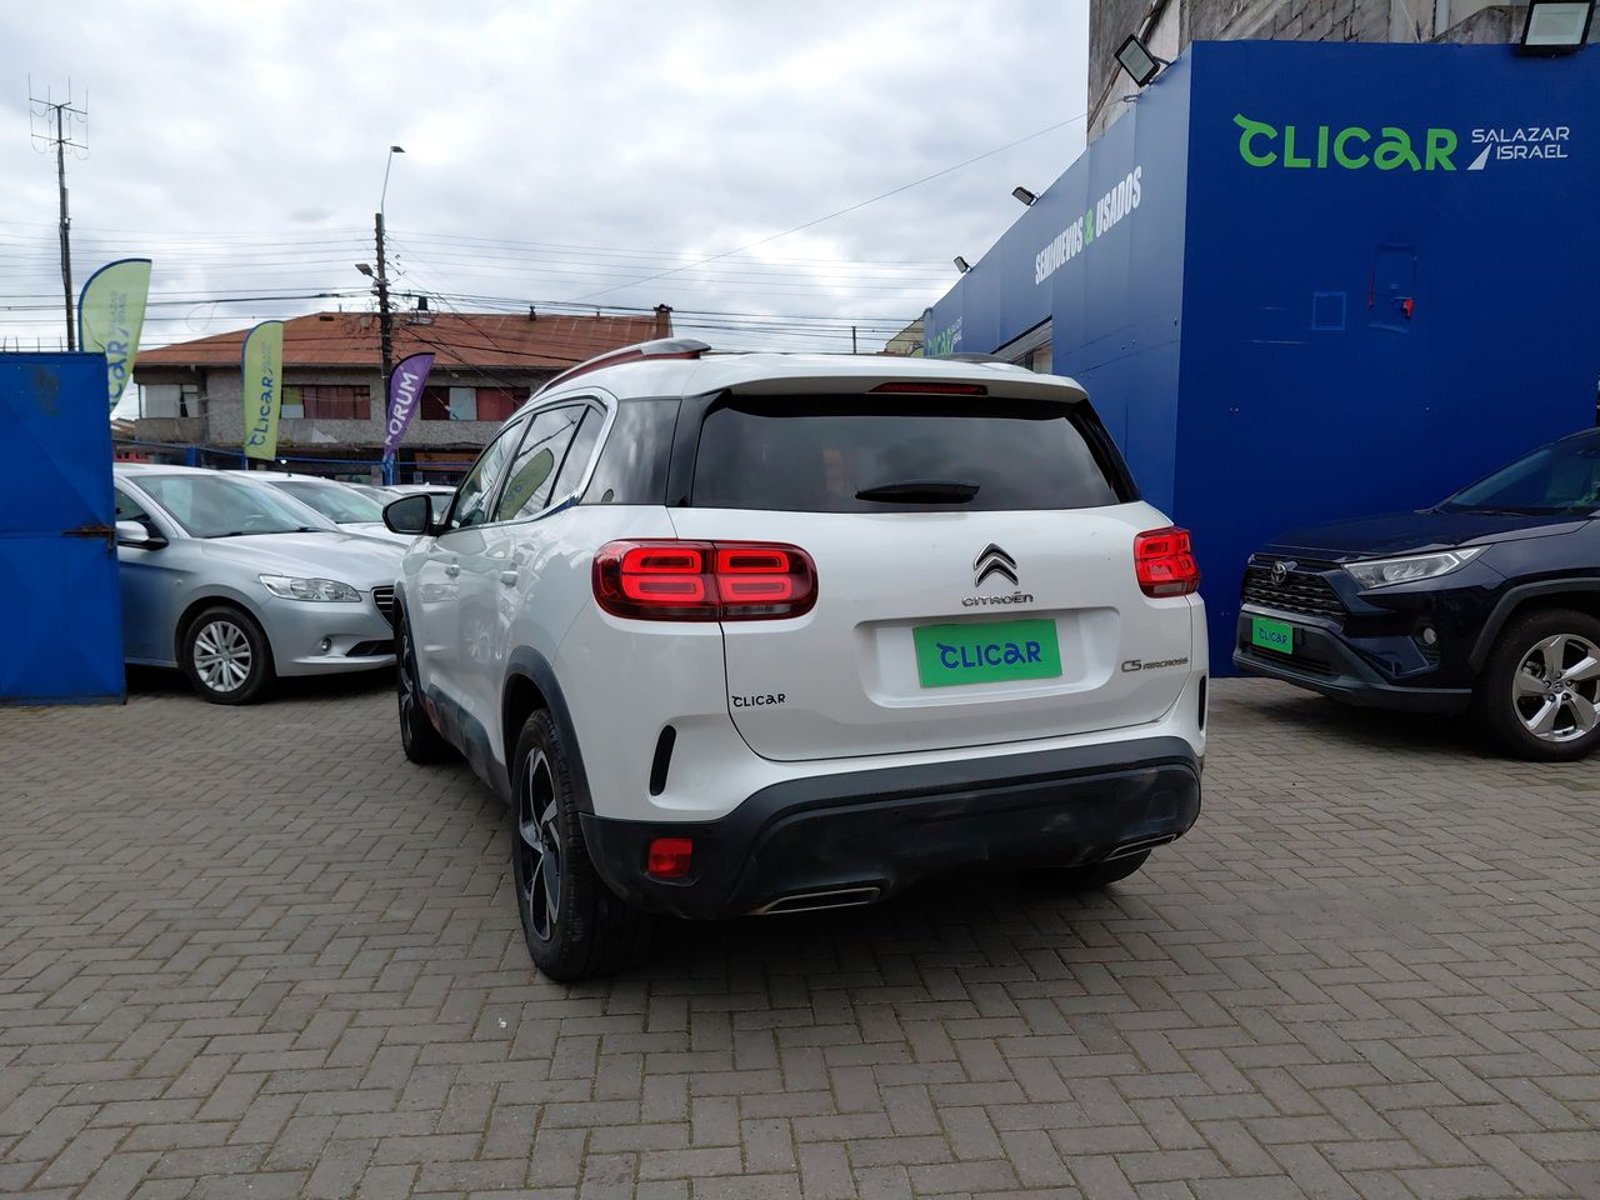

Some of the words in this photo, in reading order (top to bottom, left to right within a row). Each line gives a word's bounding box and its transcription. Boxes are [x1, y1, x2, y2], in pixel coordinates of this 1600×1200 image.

[1471, 126, 1571, 144] SALAZAR
[1496, 143, 1569, 161] ISRAEL
[1035, 216, 1084, 285] SEMINUEVOS
[1084, 208, 1094, 246] &
[1095, 165, 1142, 238] USADOS
[1121, 659, 1142, 673] C5
